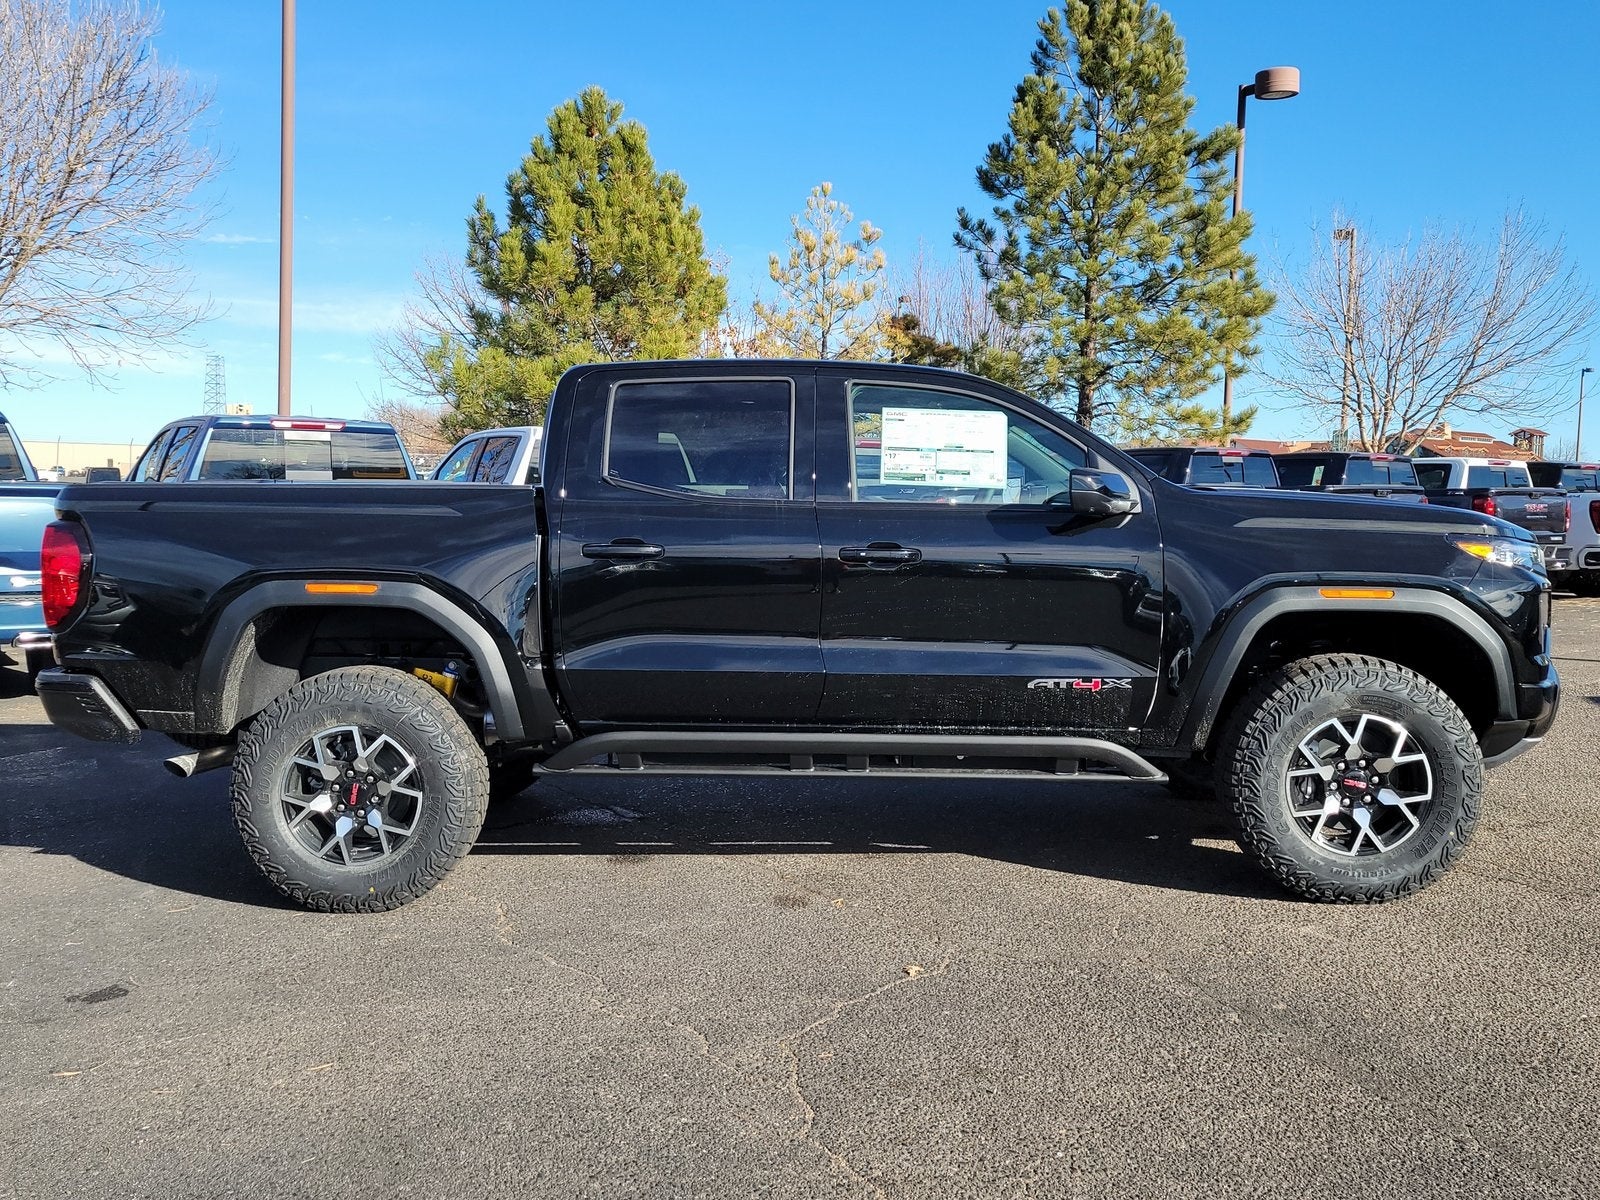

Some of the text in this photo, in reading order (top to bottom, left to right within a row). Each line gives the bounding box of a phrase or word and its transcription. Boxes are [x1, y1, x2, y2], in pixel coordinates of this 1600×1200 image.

[1027, 678, 1132, 692] AT4X
[1267, 710, 1316, 835] GOODYEAR
[1343, 778, 1367, 789] GMC
[350, 782, 359, 805] GMC
[1411, 745, 1458, 859] WRANGLER
